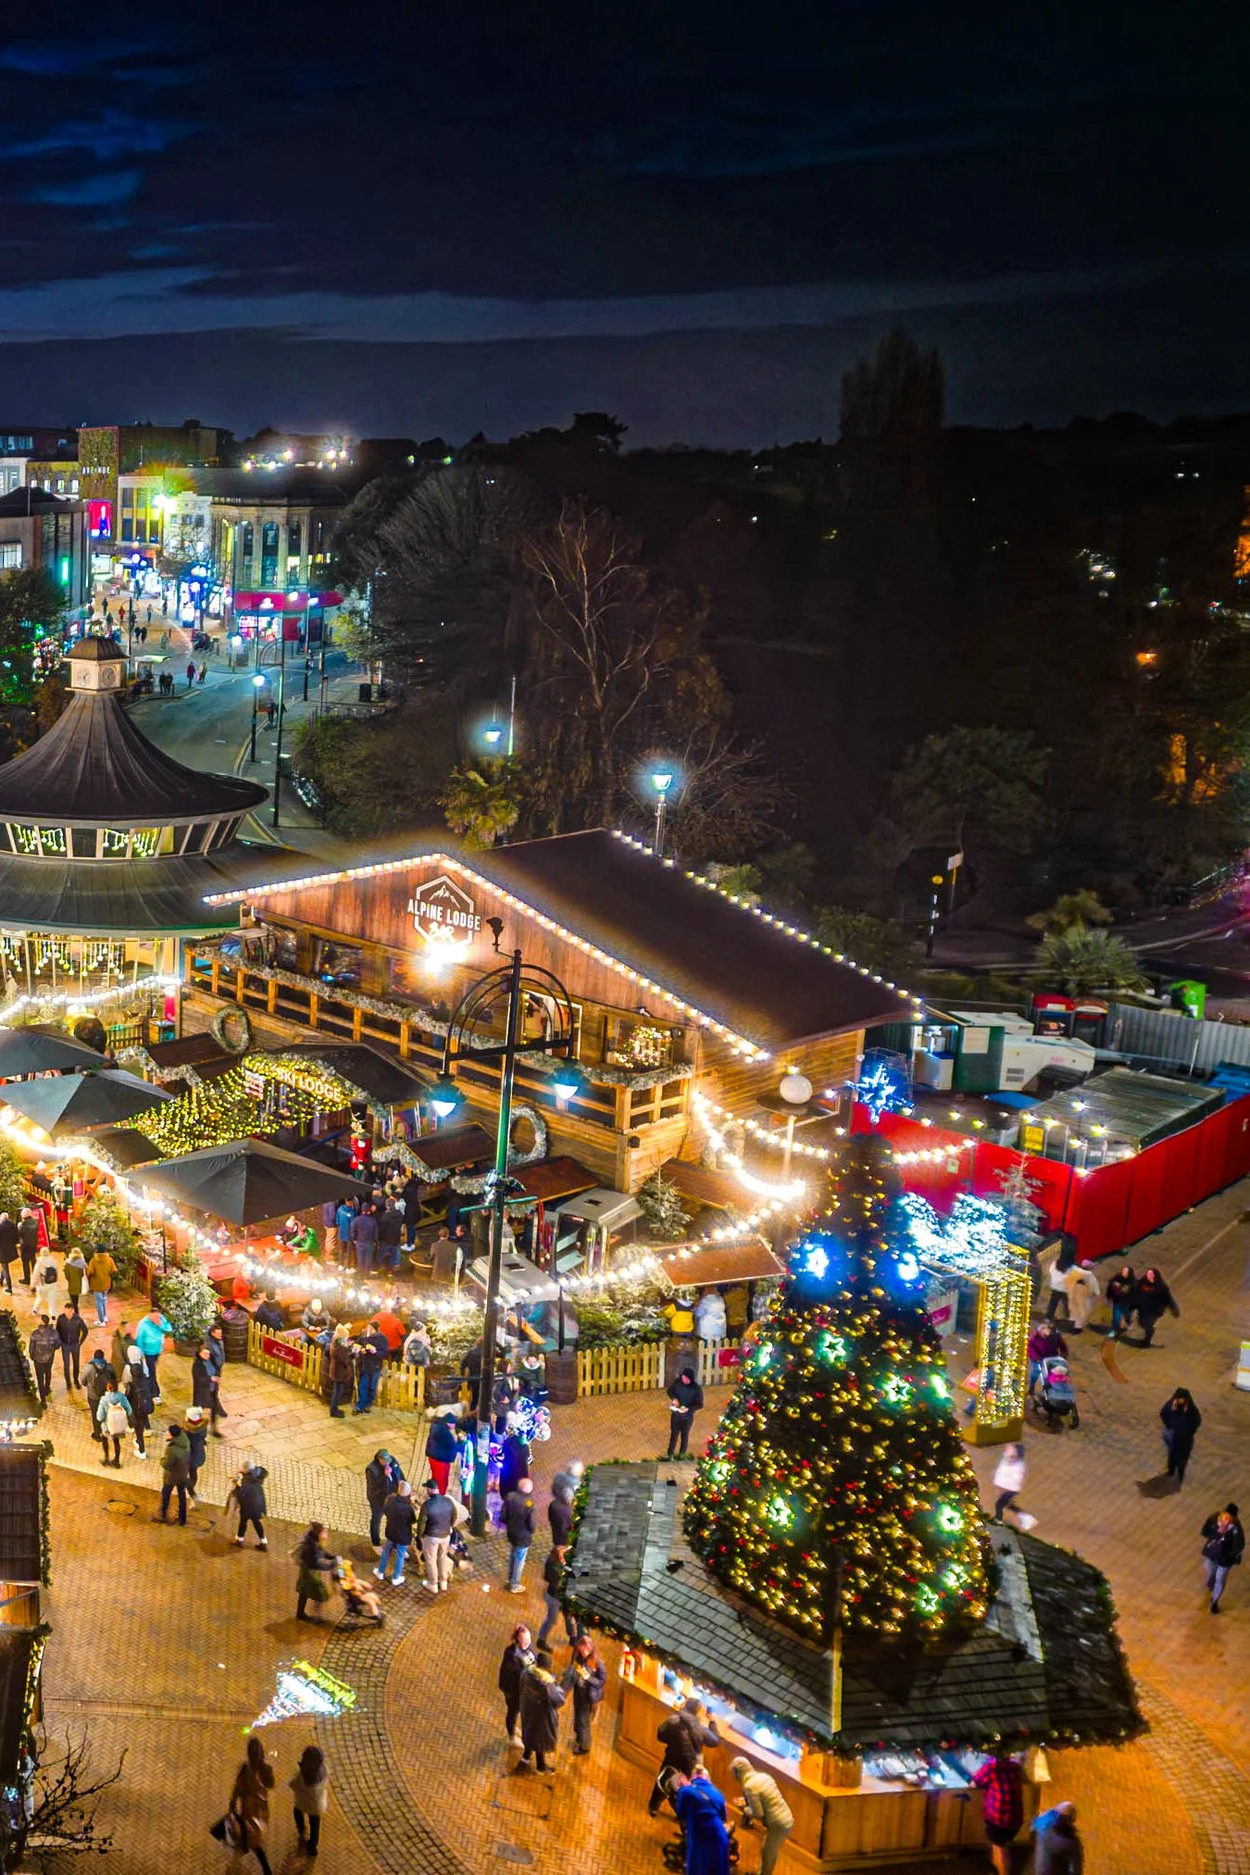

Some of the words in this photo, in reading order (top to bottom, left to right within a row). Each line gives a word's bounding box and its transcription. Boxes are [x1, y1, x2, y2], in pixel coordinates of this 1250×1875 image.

[407, 899, 443, 921] ALPINE
[446, 908, 481, 931] LODGE
[277, 1067, 296, 1088] SKI
[299, 1075, 342, 1102] LODGE
